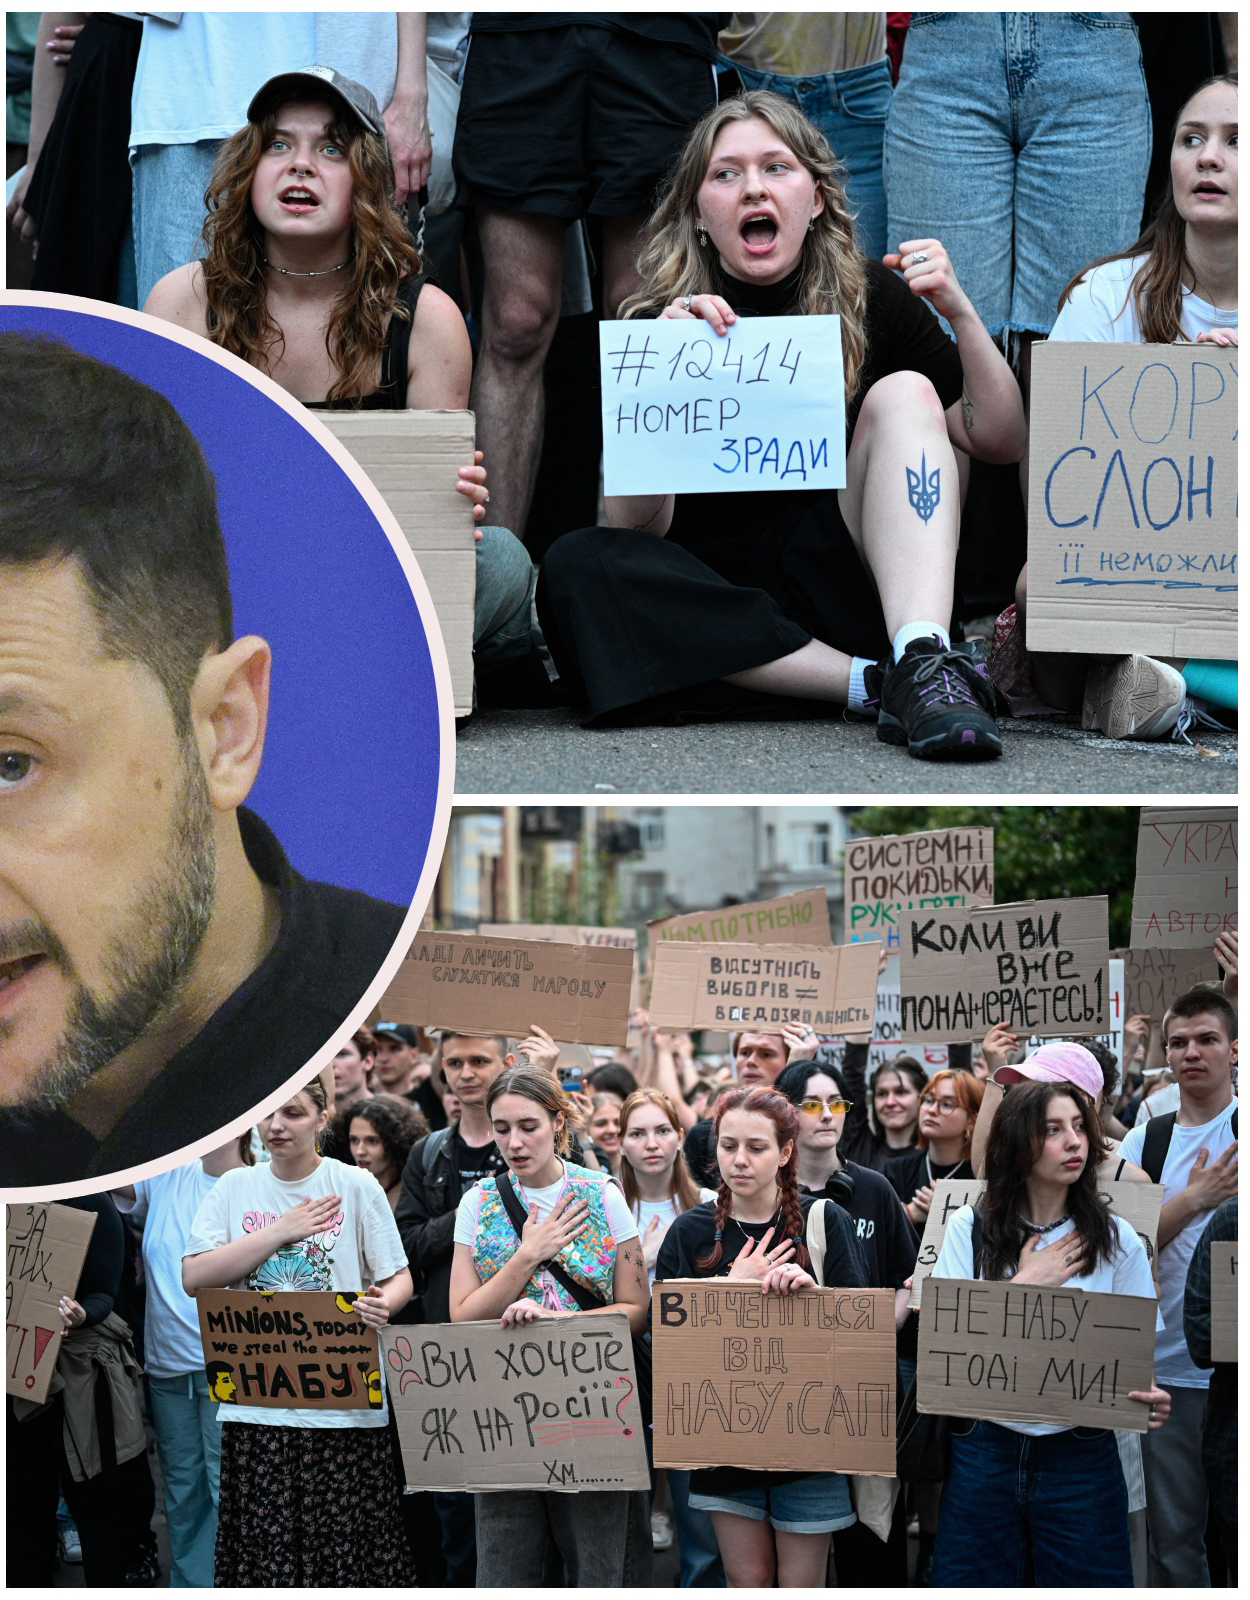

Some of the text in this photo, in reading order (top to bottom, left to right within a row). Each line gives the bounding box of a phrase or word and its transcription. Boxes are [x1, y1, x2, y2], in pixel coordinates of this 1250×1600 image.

[608, 334, 802, 387] #12414
[616, 398, 741, 434] НОМЕР
[713, 437, 828, 481] ЗРАДИ
[1044, 446, 1215, 530] СЛОН
[710, 901, 814, 942] ПОТРІБНО
[911, 910, 1063, 959] КОЛИ ВИ
[462, 947, 534, 971] ЛИЧИТЬ
[710, 956, 821, 980] ВІДСУТНІСТЬ
[433, 966, 607, 999] СЛУХАТИСЯ НАРОДУ
[707, 979, 789, 998] ВИБОРІВ
[933, 1286, 990, 1335] НЕ
[1002, 1291, 1090, 1343] НАБУ
[238, 1362, 353, 1400] НАБУ
[1038, 1357, 1120, 1408] МИ!
[666, 1379, 785, 1436] НАБУ
[797, 1381, 890, 1438] САП
[421, 1406, 465, 1462] ЯК
[473, 1406, 514, 1453] НА
